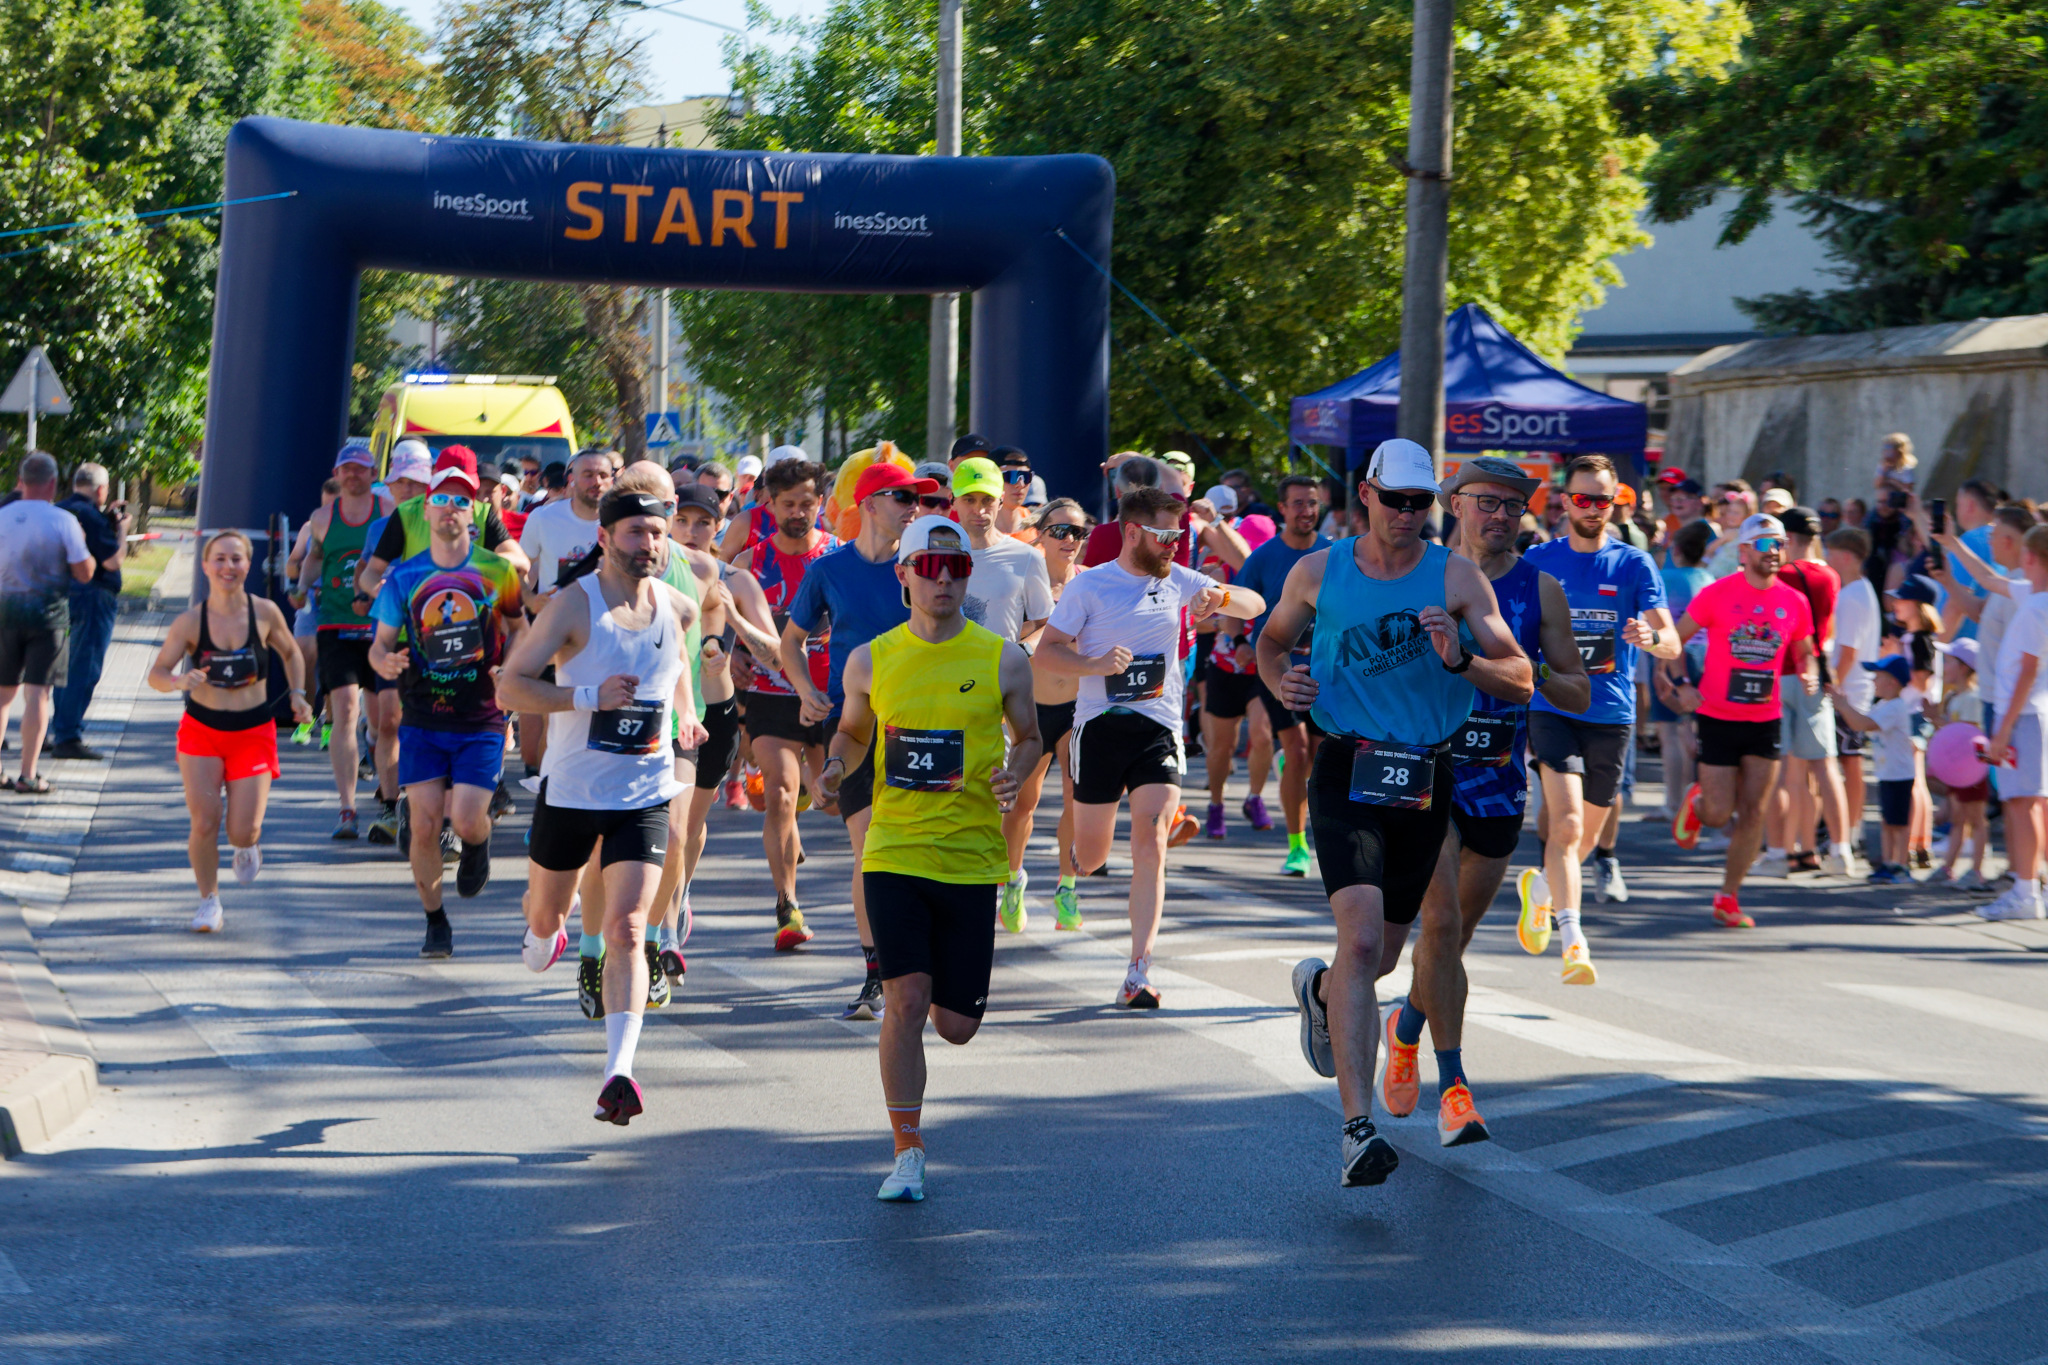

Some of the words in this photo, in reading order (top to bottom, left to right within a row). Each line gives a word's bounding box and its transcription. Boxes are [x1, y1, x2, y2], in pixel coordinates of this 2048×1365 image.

[434, 190, 528, 216] inesSport
[564, 181, 804, 249] START
[834, 211, 928, 234] inesSport
[1447, 406, 1571, 441] esSport
[443, 637, 464, 653] 75
[1368, 634, 1429, 666] PÓŁMARATON
[223, 665, 234, 678] 4
[1127, 671, 1148, 686] 16
[1744, 682, 1761, 694] 11
[617, 718, 644, 736] 87
[1465, 730, 1491, 748] 93
[907, 751, 934, 770] 24
[1381, 766, 1410, 786] 28
